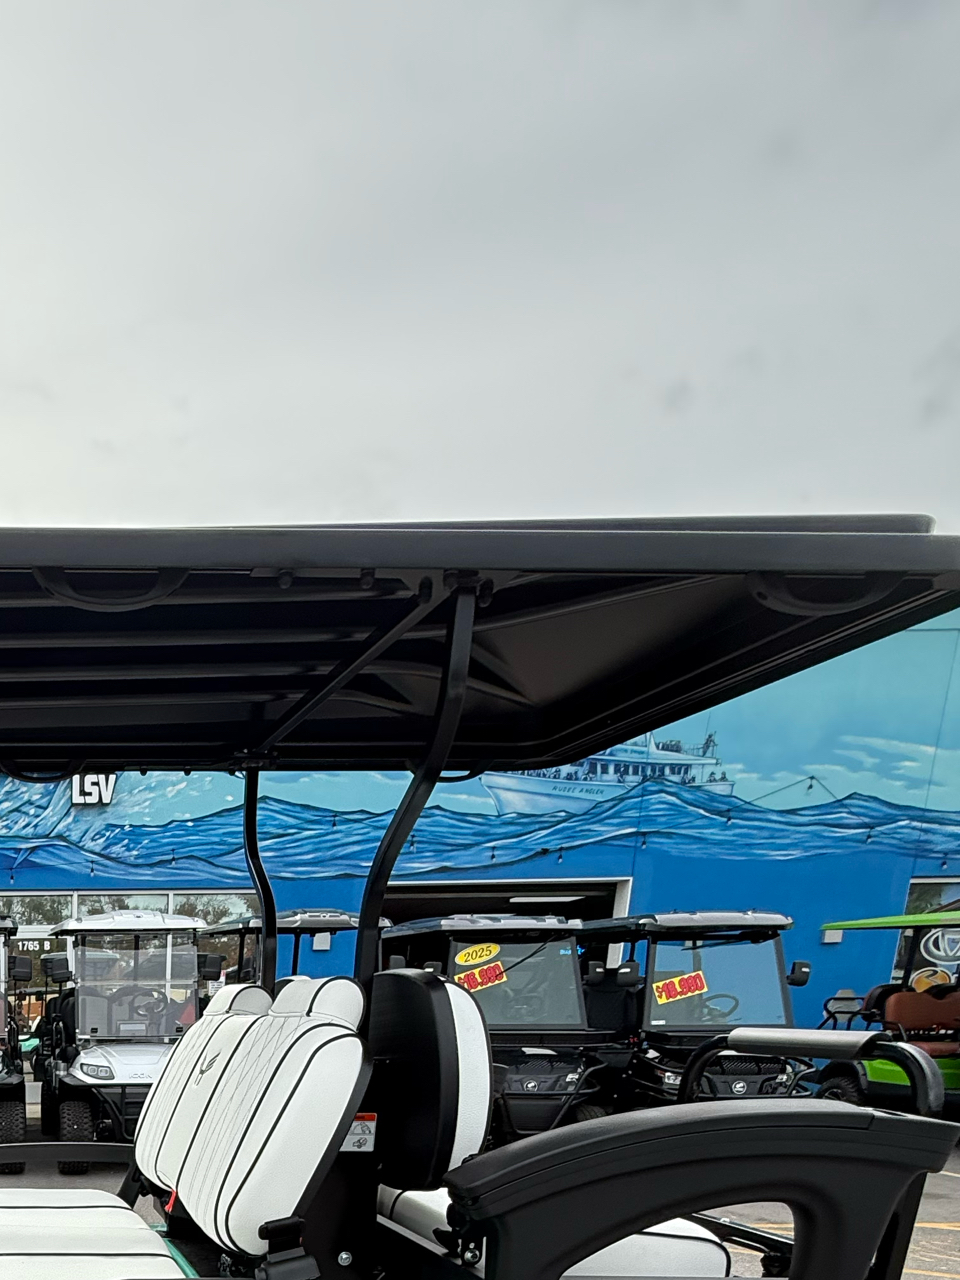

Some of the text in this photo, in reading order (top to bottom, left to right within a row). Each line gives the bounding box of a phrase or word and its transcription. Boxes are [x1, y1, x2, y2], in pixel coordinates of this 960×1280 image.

[72, 774, 116, 804] LSV
[17, 940, 51, 951] 1765 B
[463, 945, 492, 962] 2025
